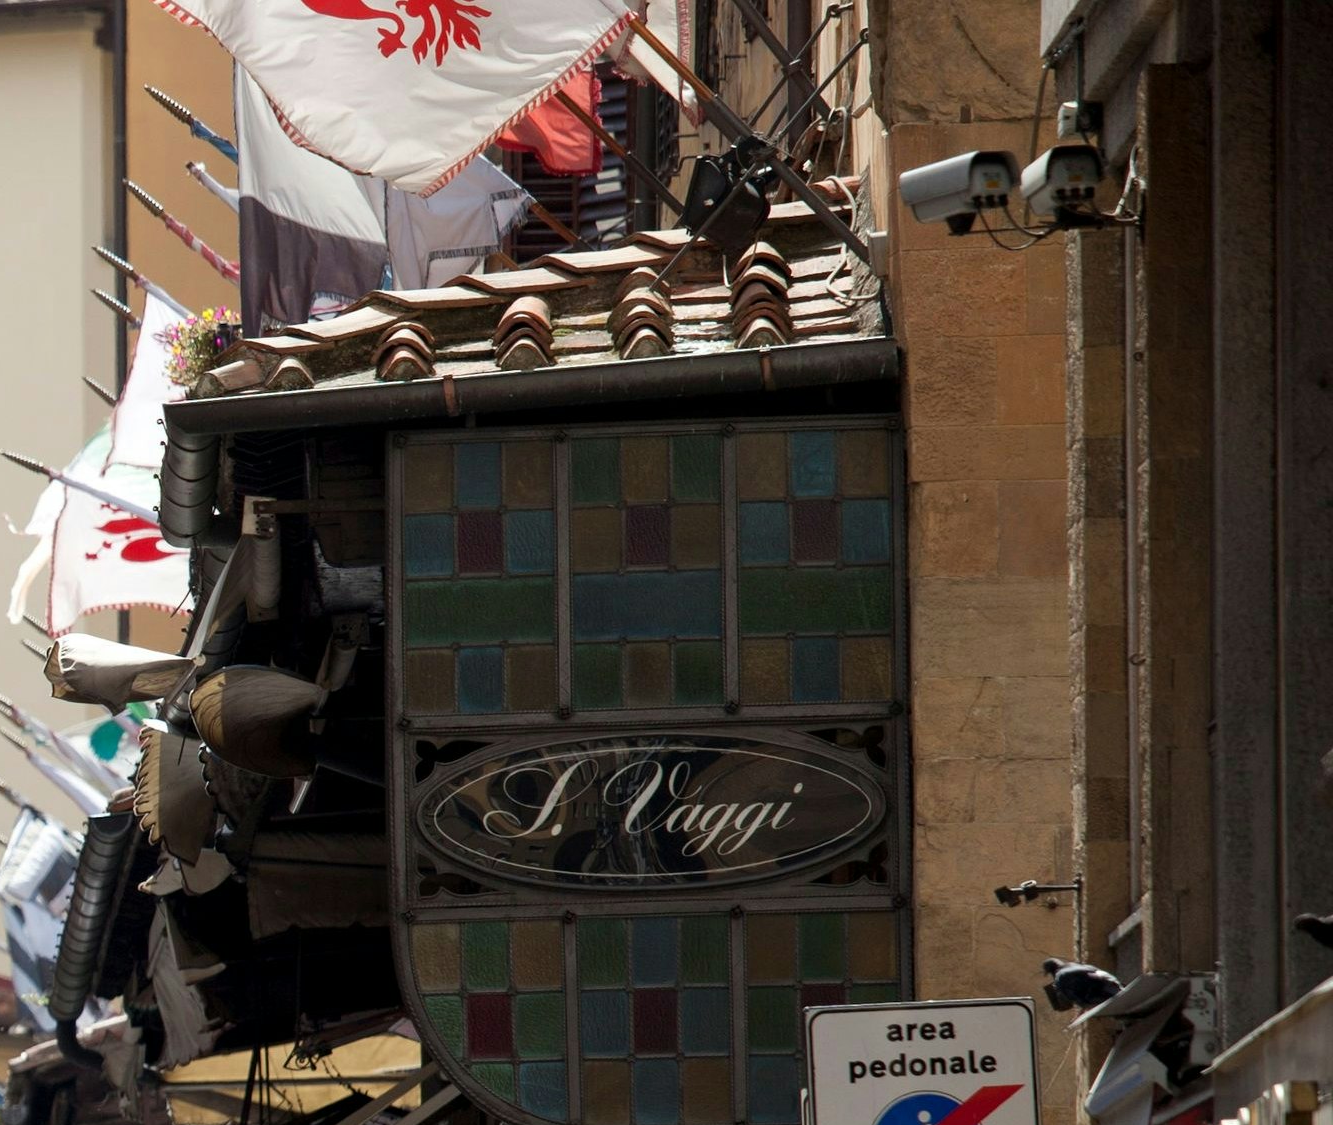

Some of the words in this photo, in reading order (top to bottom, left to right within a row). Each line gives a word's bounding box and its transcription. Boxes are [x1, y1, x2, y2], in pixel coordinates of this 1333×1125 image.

[603, 761, 804, 857] Vaggi
[886, 1021, 956, 1042] area
[849, 1050, 997, 1083] pedonale
